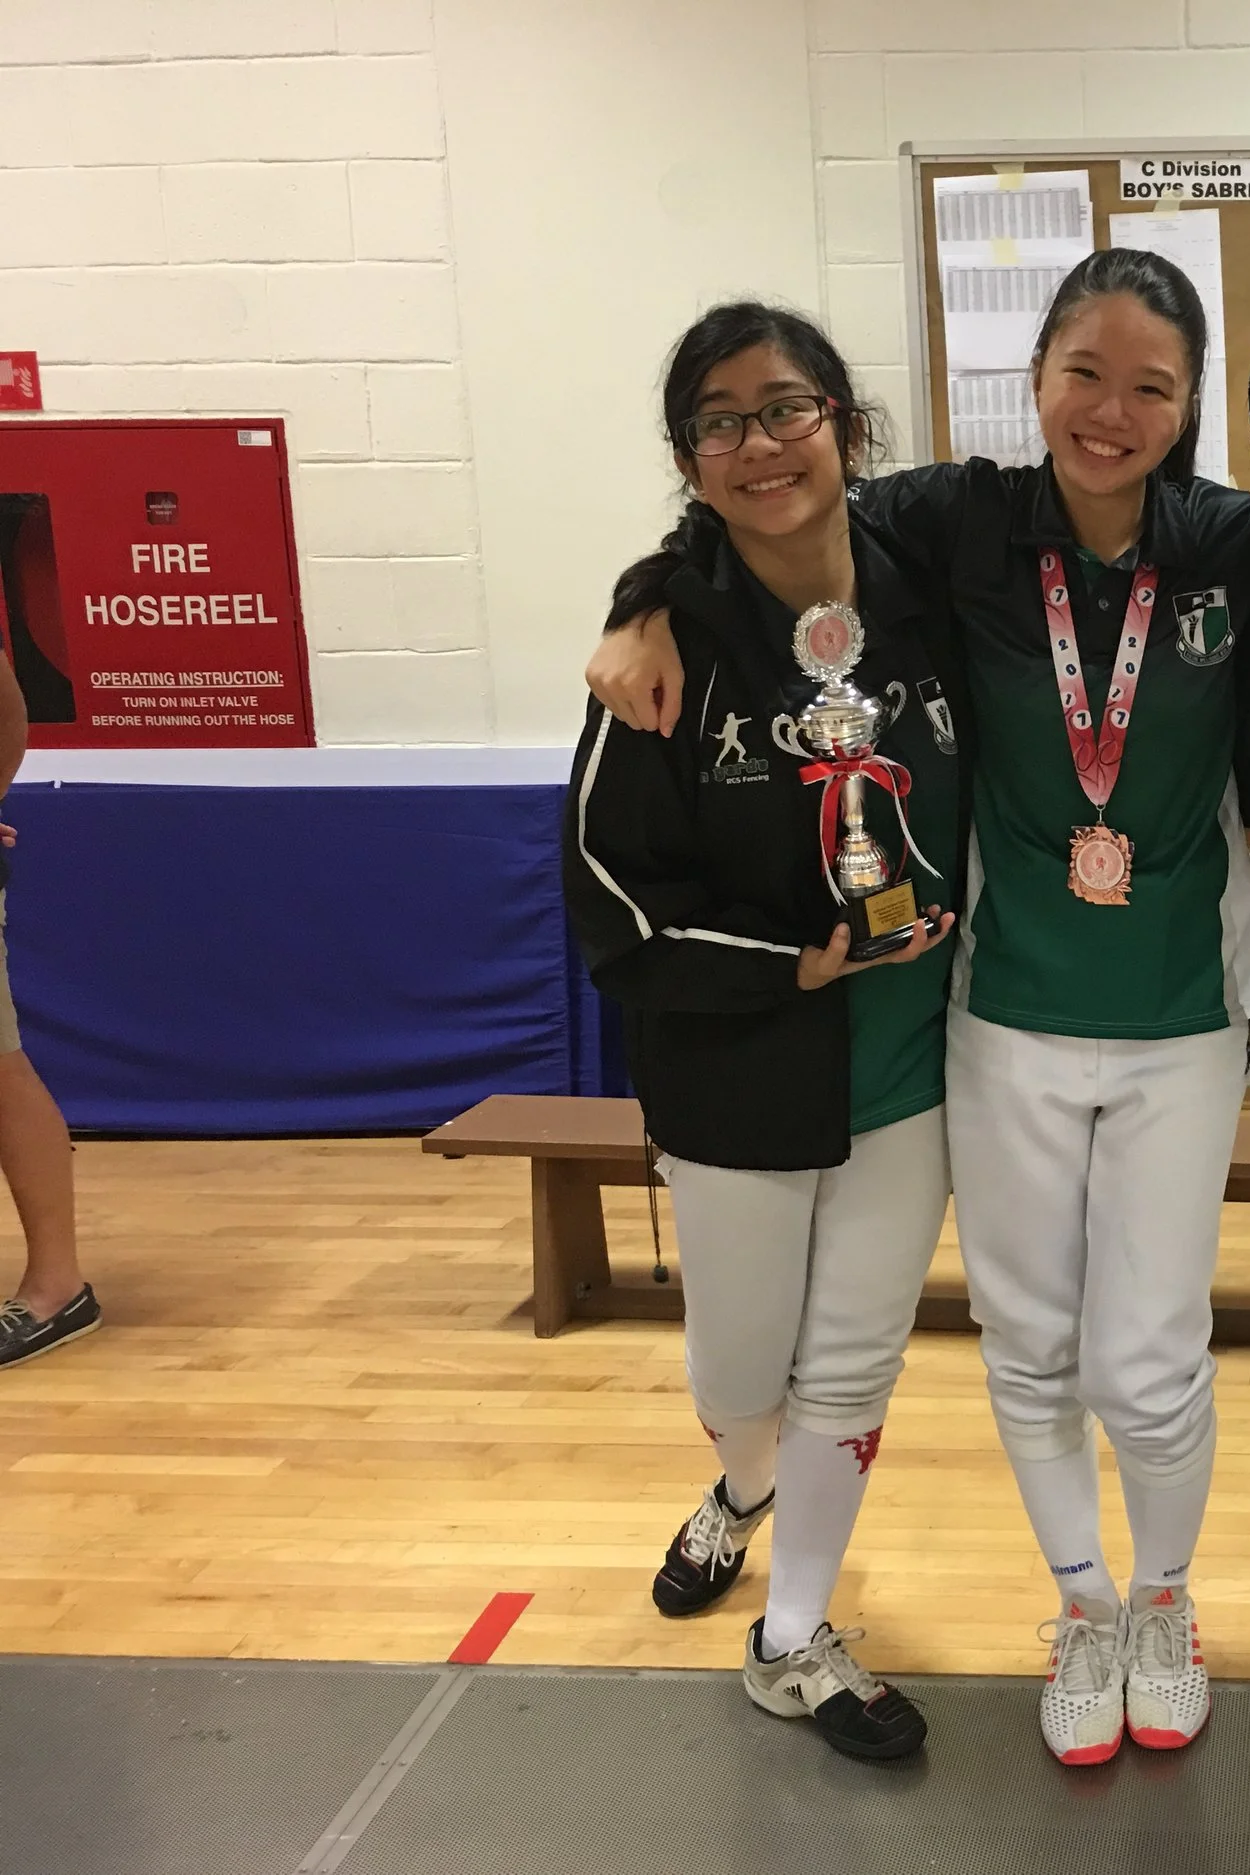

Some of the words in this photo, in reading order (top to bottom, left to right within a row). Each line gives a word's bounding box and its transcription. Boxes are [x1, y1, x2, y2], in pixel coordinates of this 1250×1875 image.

[1141, 160, 1155, 176] C
[1162, 160, 1242, 176] Division
[131, 543, 211, 574] FIRE
[84, 593, 278, 626] HOSEREEL
[90, 671, 175, 686] OPERATING
[179, 670, 284, 686] INSTRUCTION:
[122, 697, 156, 708] TURN
[159, 697, 178, 708] ON
[180, 697, 215, 708] INLET
[217, 696, 259, 707] VALVE
[92, 715, 143, 726] BEFORE
[145, 715, 201, 726] RUNNING
[204, 715, 232, 726] OUT
[232, 714, 257, 726] THE
[260, 714, 295, 725] HOSE
[726, 777, 741, 785] RCS
[743, 774, 770, 783] Fencing
